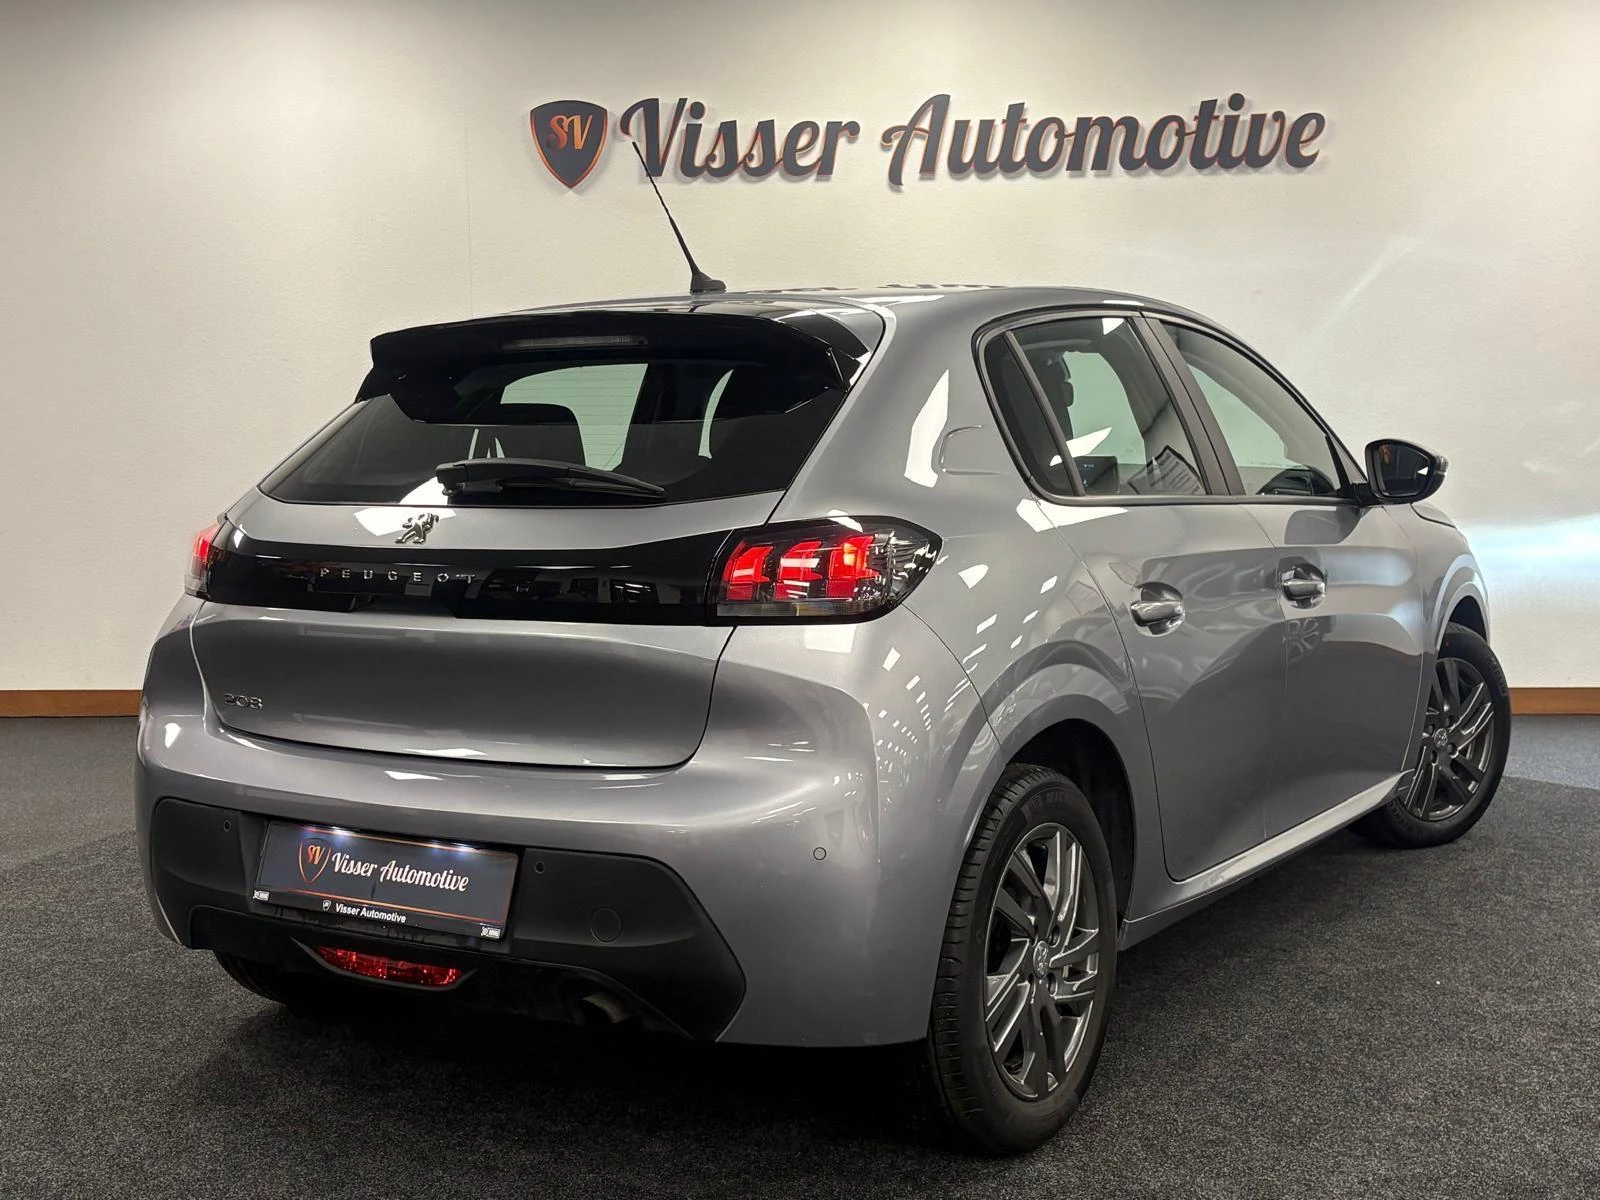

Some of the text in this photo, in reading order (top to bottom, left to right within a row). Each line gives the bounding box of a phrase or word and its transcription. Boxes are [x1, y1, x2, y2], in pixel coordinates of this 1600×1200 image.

[619, 97, 860, 178] Visser
[880, 93, 1326, 187] Automotive
[320, 567, 475, 584] PEUGEOT
[331, 852, 377, 878] Visser
[380, 859, 469, 892] Automotive
[335, 902, 360, 916] Visser
[360, 907, 407, 924] Automotive
